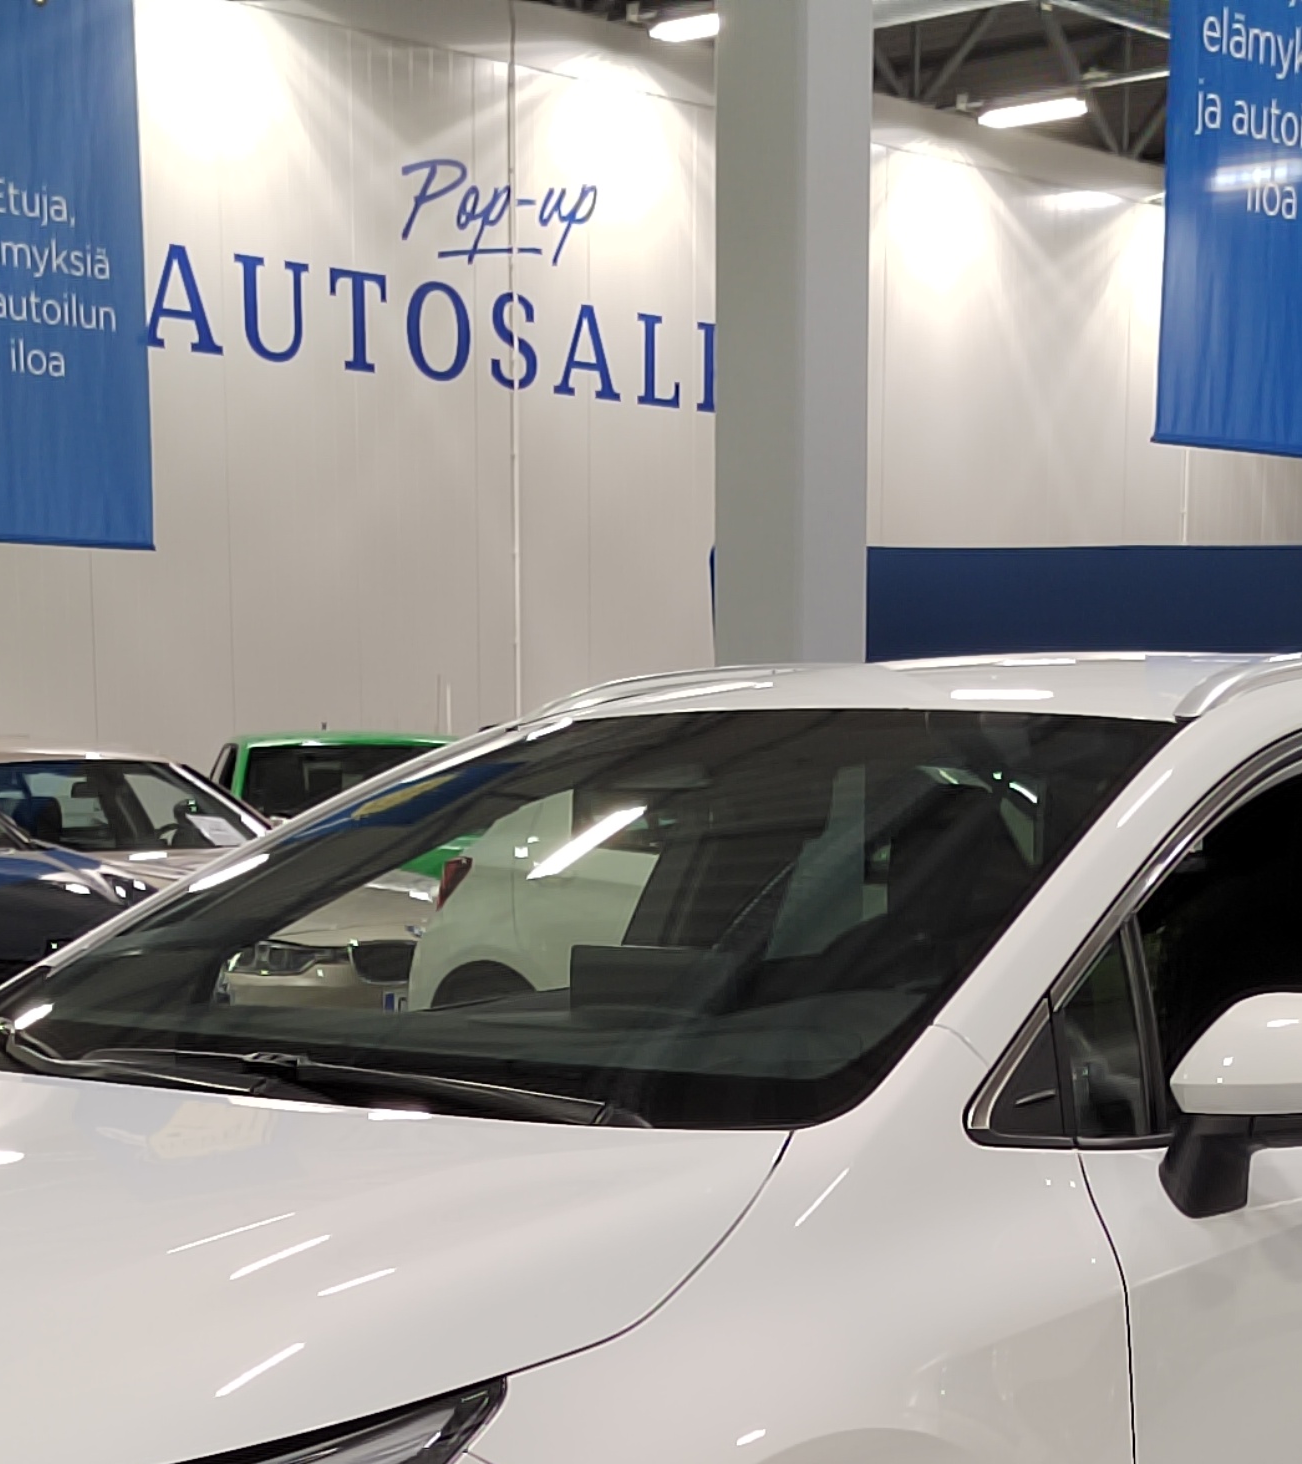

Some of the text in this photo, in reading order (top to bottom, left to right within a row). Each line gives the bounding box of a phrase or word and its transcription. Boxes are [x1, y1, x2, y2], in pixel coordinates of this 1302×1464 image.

[1195, 78, 1222, 135] ja
[401, 158, 598, 267] Pop-up
[10, 337, 65, 377] iloa
